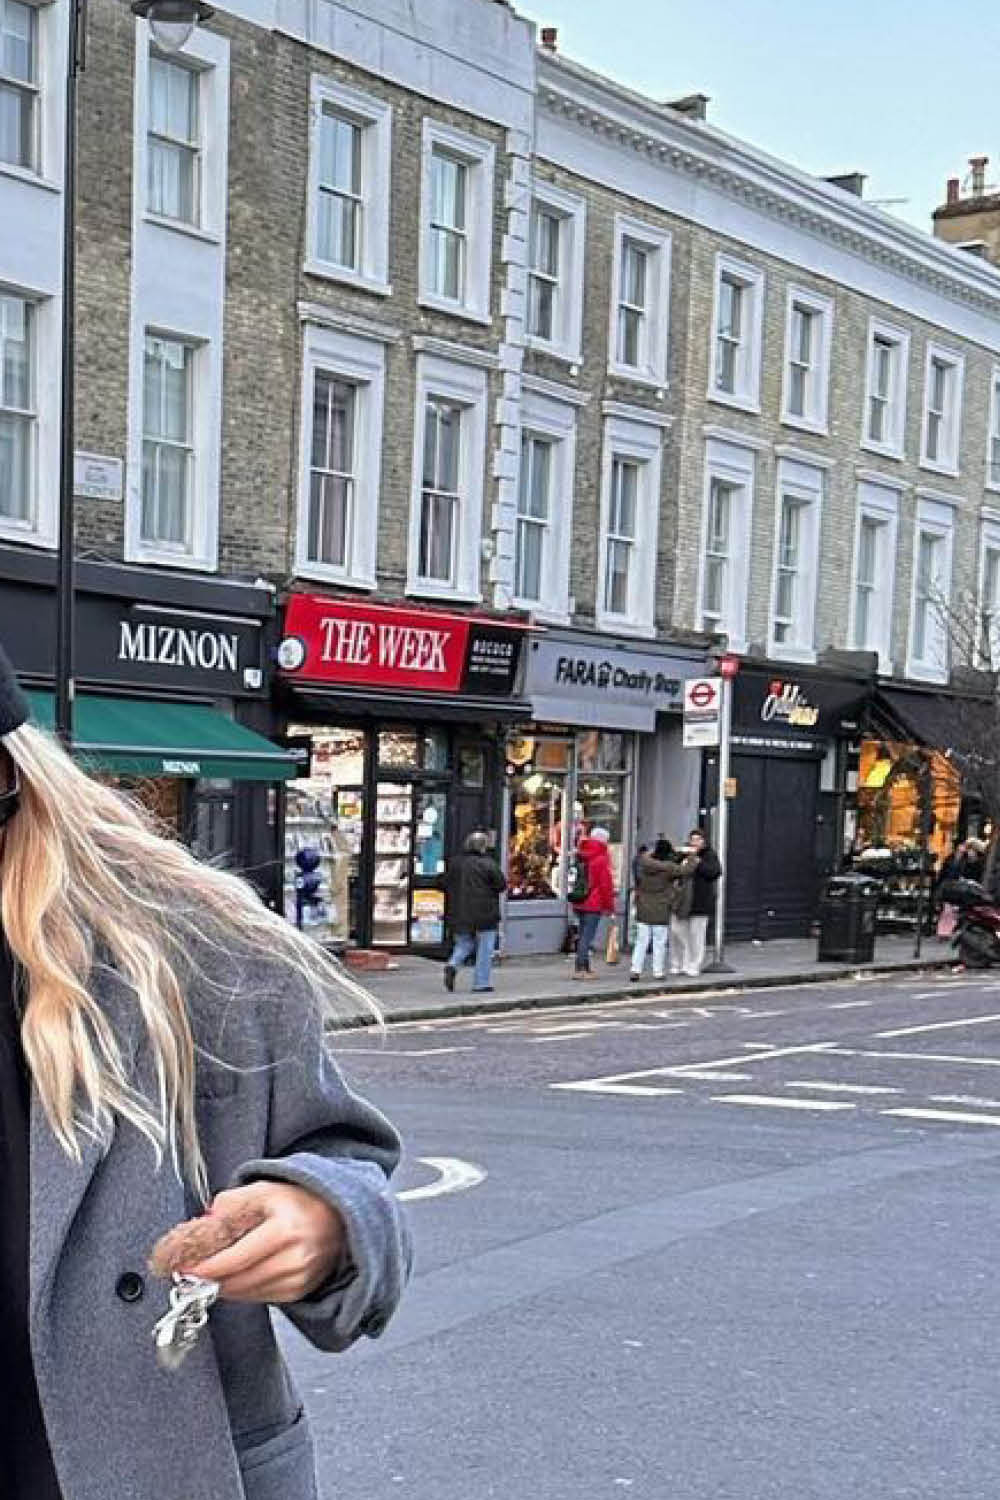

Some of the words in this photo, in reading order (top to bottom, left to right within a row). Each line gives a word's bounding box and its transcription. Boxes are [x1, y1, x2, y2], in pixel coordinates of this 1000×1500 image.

[118, 620, 240, 673] MIZNON
[319, 617, 376, 666] THE
[377, 624, 452, 673] WEEK
[555, 655, 596, 687] FARA
[612, 665, 653, 694] Charity
[654, 671, 682, 697] Shop
[162, 758, 201, 774] MIZNON
